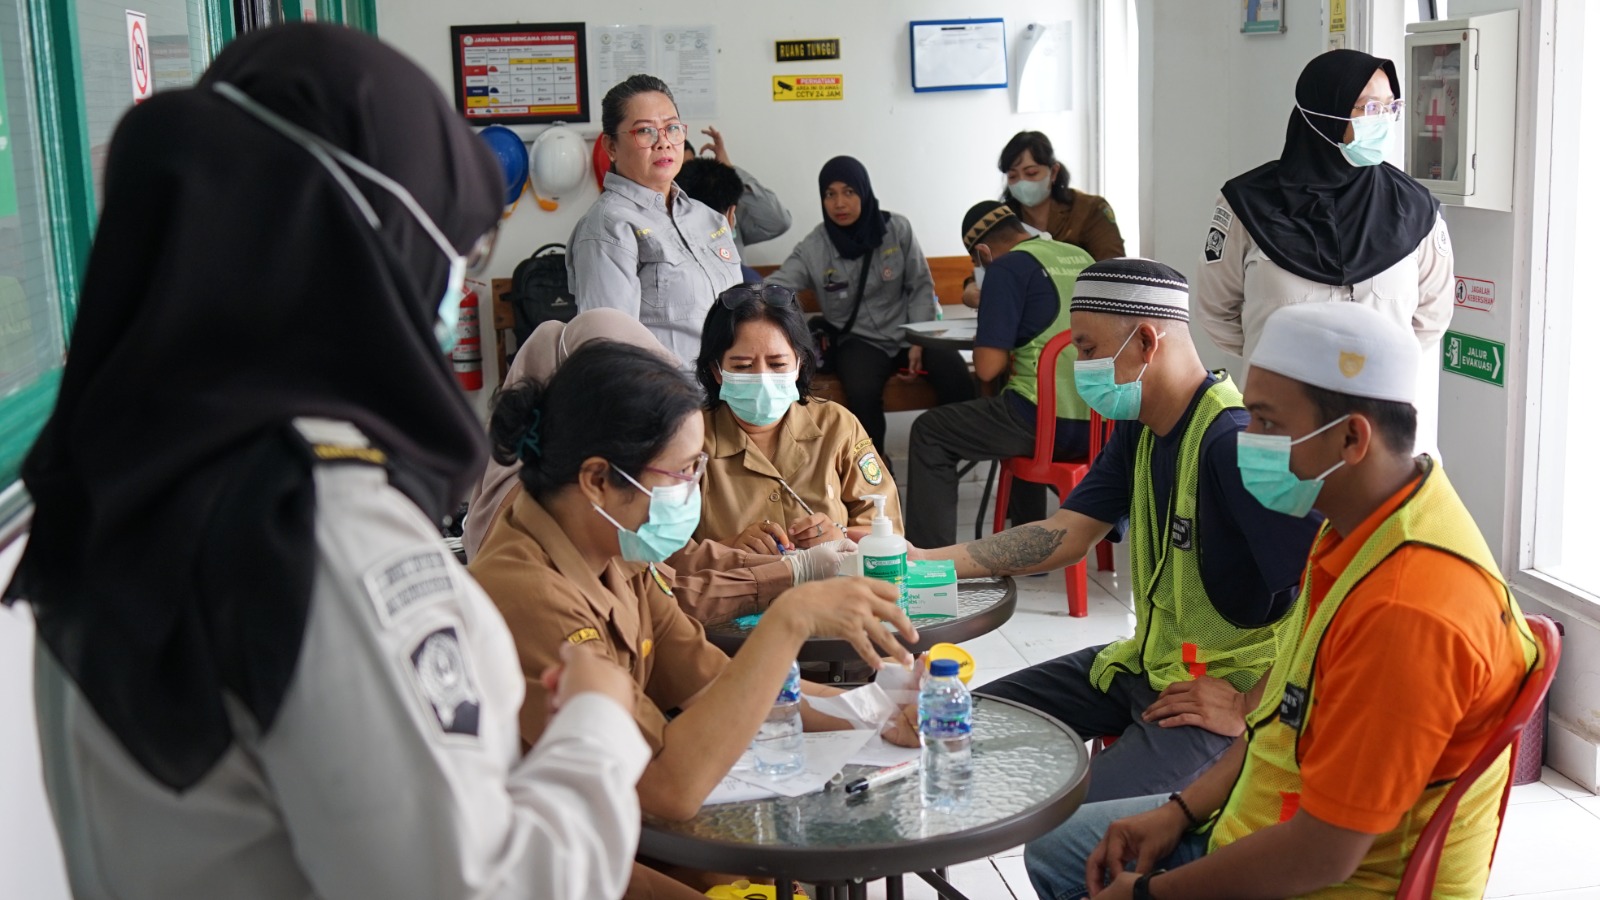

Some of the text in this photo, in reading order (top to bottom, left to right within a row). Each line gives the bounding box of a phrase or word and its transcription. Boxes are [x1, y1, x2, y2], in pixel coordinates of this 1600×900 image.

[780, 42, 836, 57] RUANG TUNGGU
[1056, 256, 1088, 264] RUTAN
[1471, 285, 1491, 296] JAGALAH
[1467, 295, 1494, 305] KEBERSIHAN
[1467, 347, 1488, 360] JALUR
[1461, 356, 1493, 372] EVAKUASI
